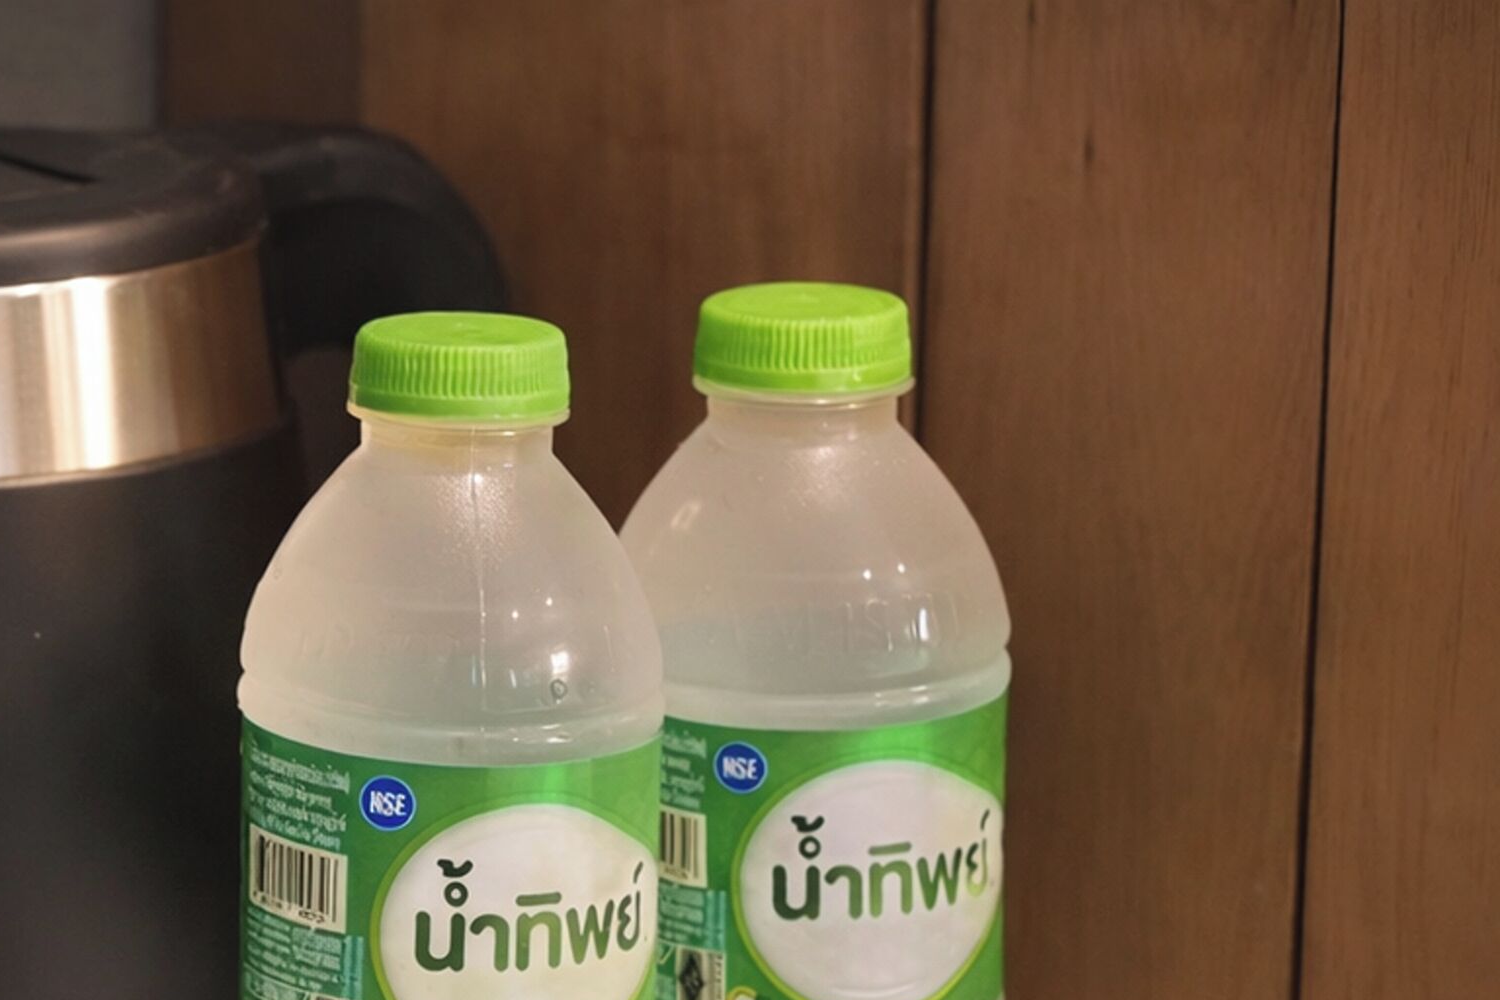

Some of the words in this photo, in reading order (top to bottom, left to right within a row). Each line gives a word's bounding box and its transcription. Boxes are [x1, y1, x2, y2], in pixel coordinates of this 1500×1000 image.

[414, 858, 644, 973] น้ำทิพย์
[772, 809, 990, 921] น้ำทิพย์
